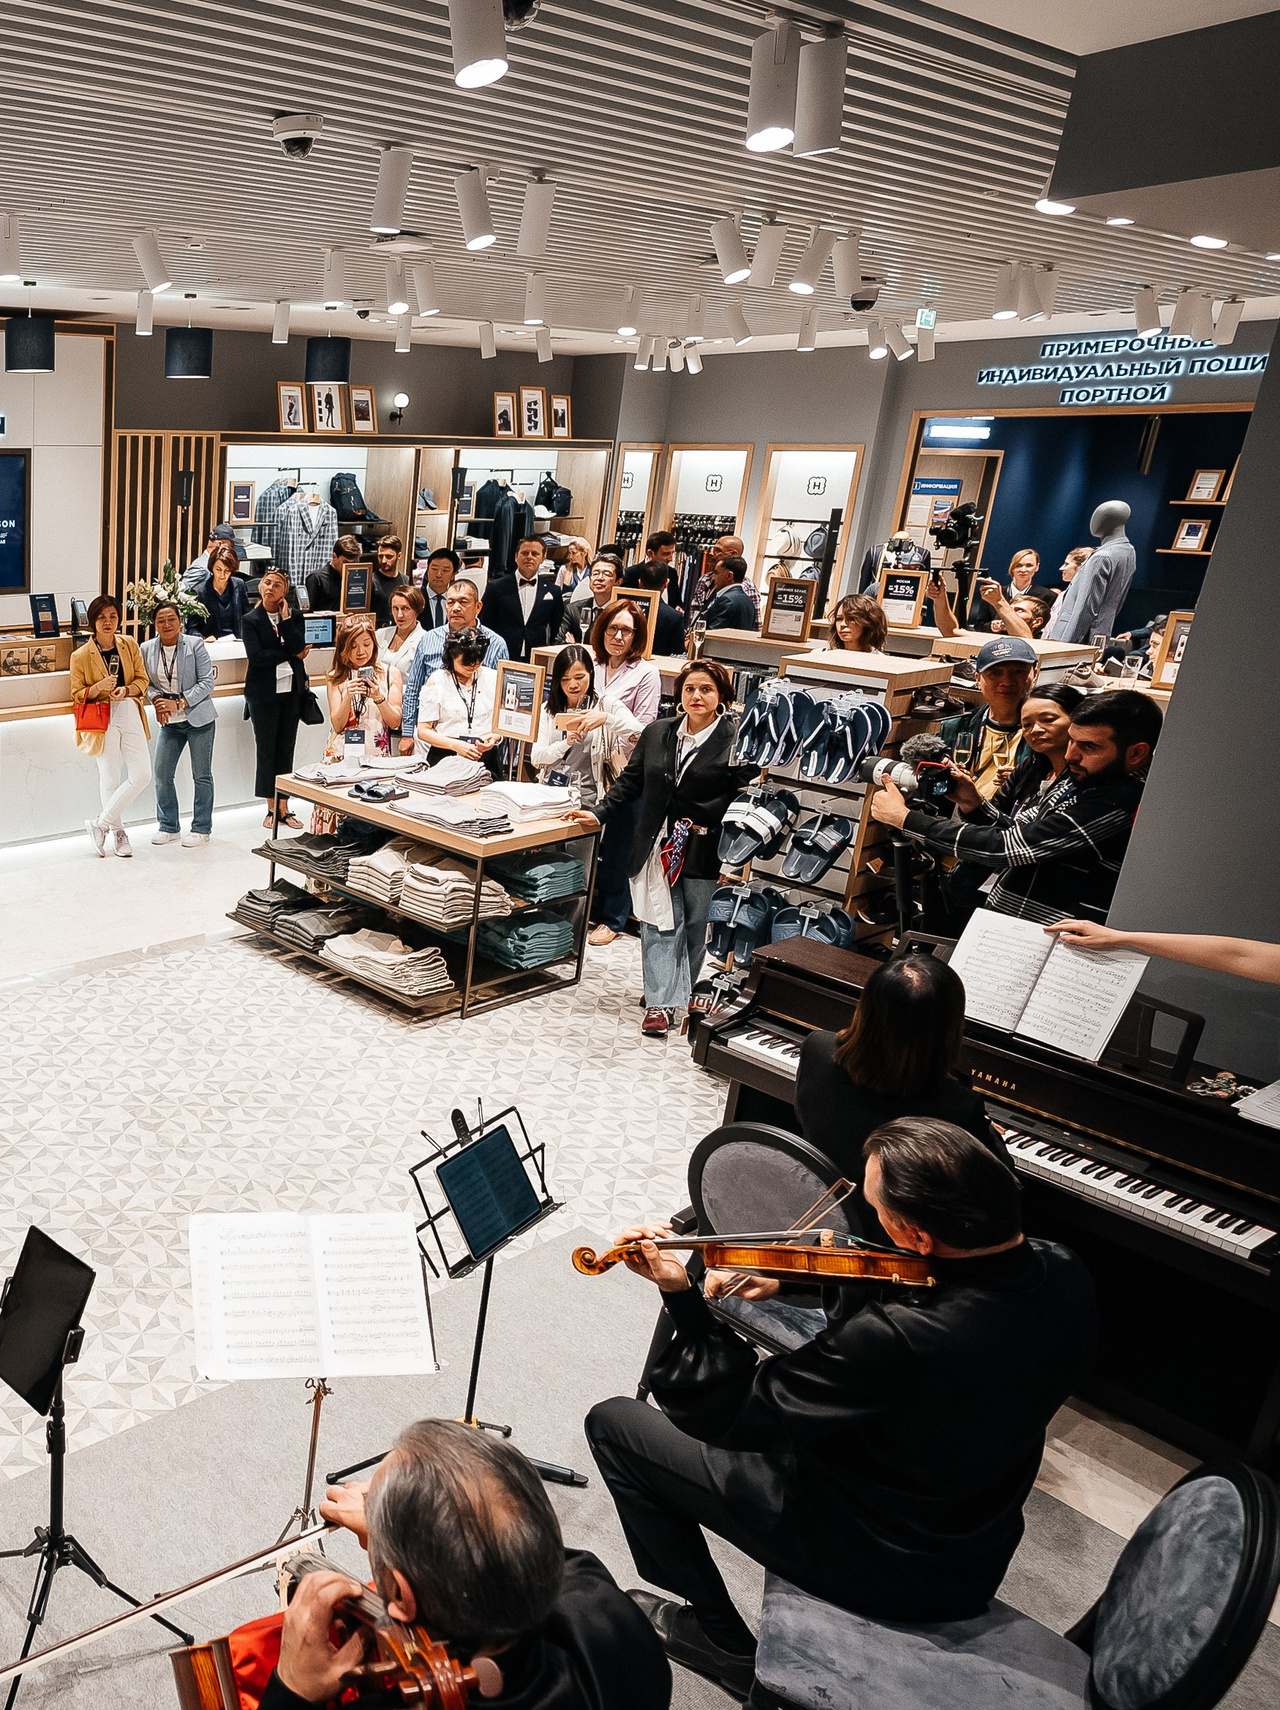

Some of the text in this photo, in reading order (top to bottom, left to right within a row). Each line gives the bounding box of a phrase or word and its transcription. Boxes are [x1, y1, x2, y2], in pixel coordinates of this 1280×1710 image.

[977, 357, 1183, 385] ИНДИВИДУАЛЬНЫЙ
[1059, 382, 1167, 403] ПОРТНОЙ
[971, 1069, 1016, 1090] YAMAHA
